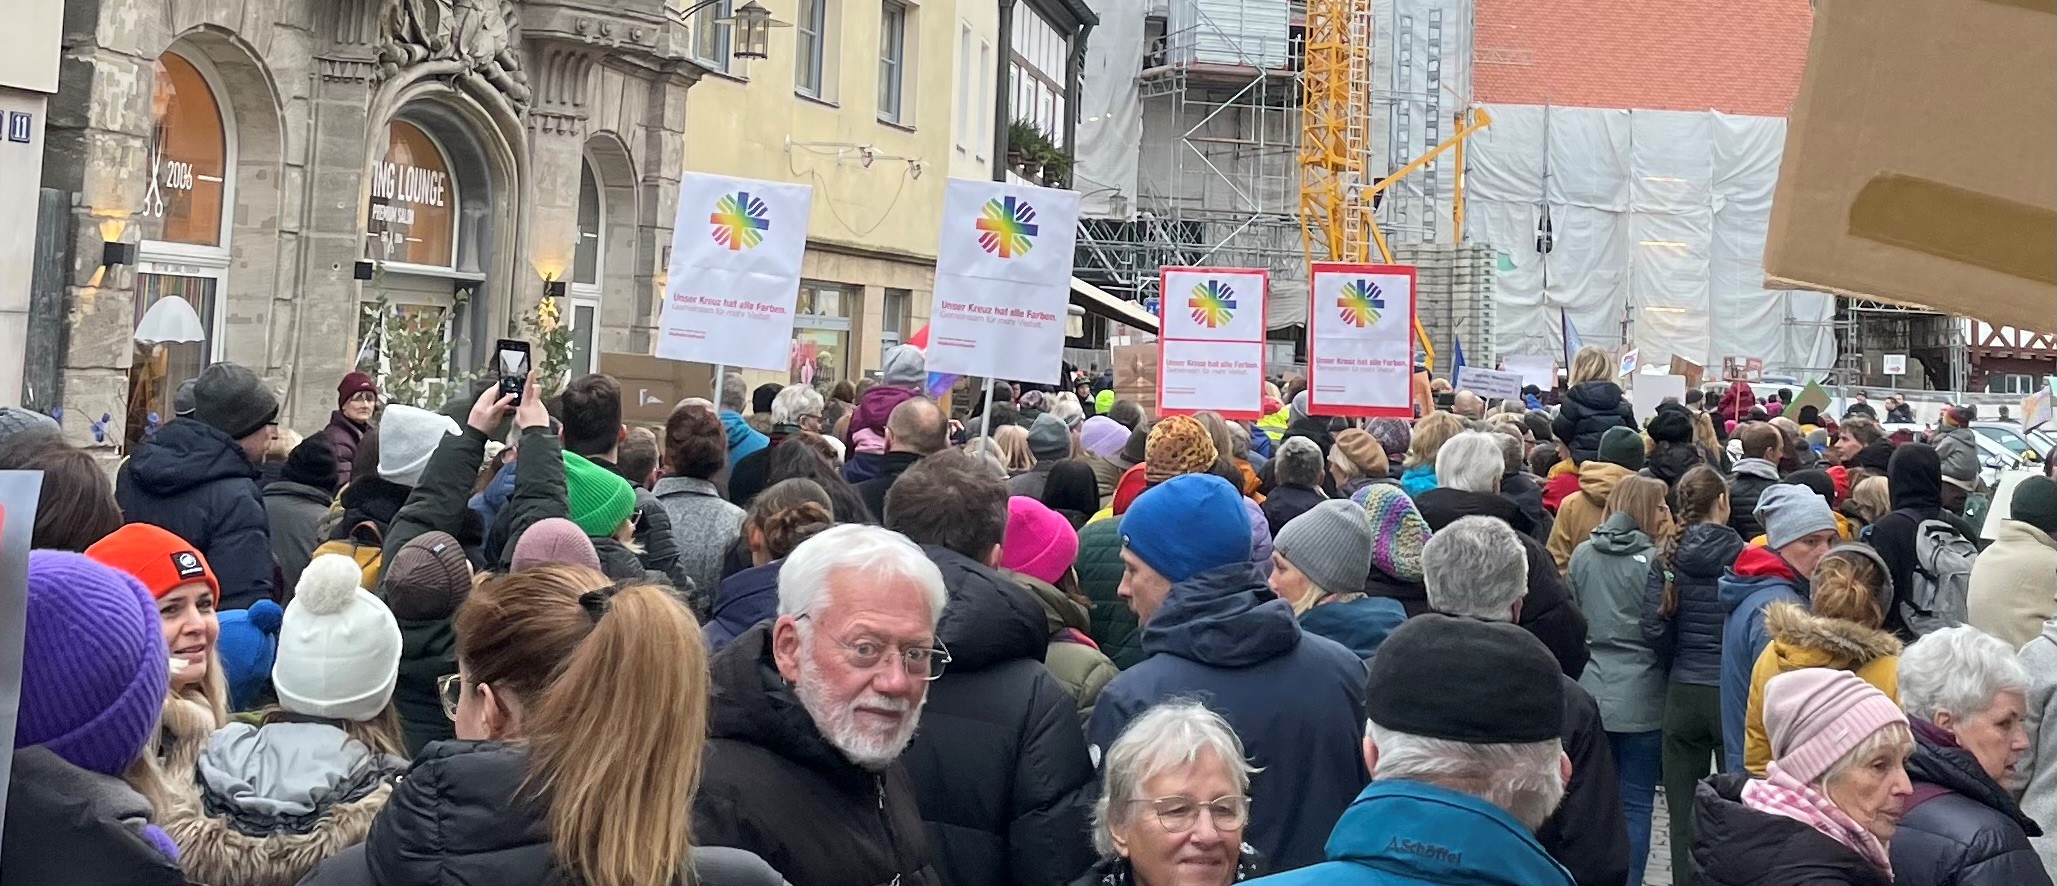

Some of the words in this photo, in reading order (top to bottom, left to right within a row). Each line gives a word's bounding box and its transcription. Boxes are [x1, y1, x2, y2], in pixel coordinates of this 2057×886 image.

[14, 115, 28, 138] 11
[166, 160, 193, 190] 2006
[373, 160, 396, 200] ING
[398, 164, 446, 207] LOUNGE
[673, 293, 697, 303] Unser
[700, 296, 721, 306] Kreuz
[724, 299, 737, 308] hat
[739, 301, 754, 310] alle
[756, 302, 786, 313] Farben.
[942, 300, 966, 311] Unser
[968, 304, 992, 314] Kreuz
[994, 306, 1008, 315] hat
[1010, 308, 1024, 317] alle
[1027, 310, 1056, 321] Farben.
